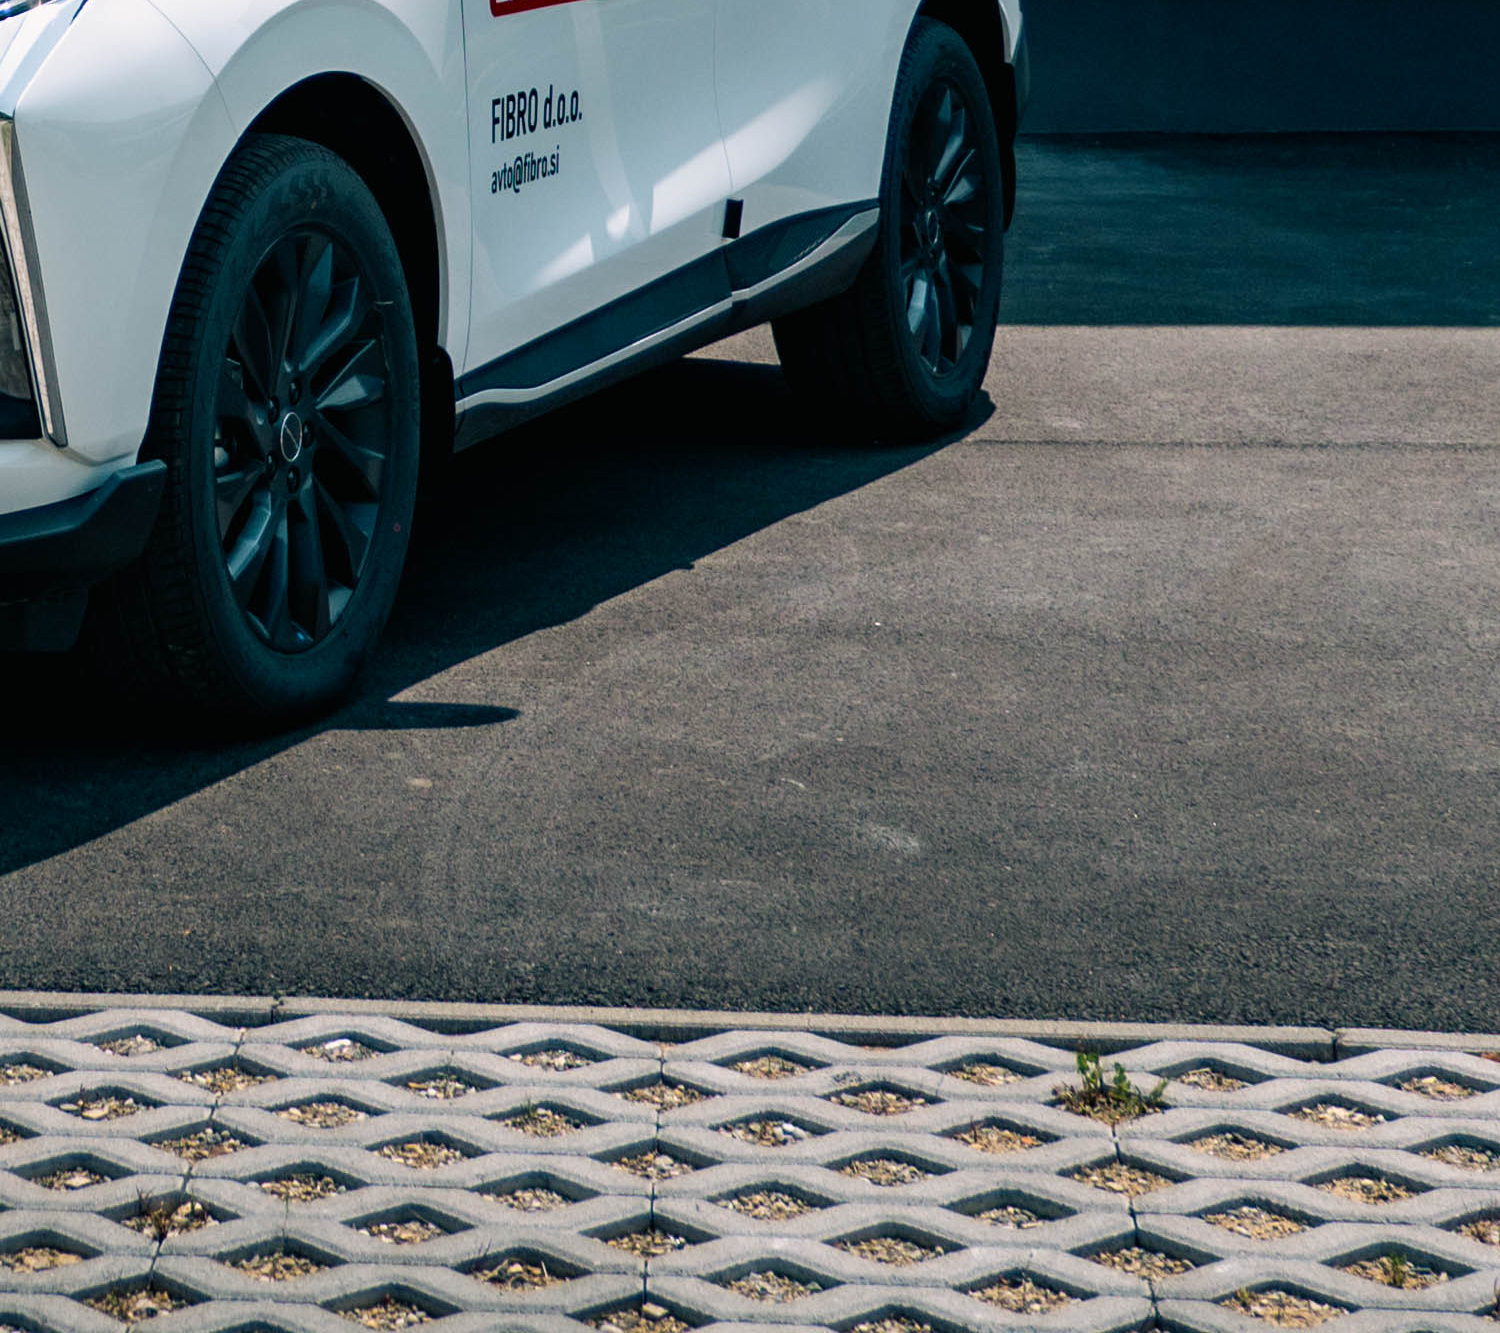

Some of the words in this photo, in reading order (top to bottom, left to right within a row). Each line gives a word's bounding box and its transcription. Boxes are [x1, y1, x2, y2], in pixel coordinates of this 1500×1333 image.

[491, 87, 539, 144] FIBRO
[543, 84, 583, 130] d.o.o.
[491, 144, 560, 194] avto@fibro.si
